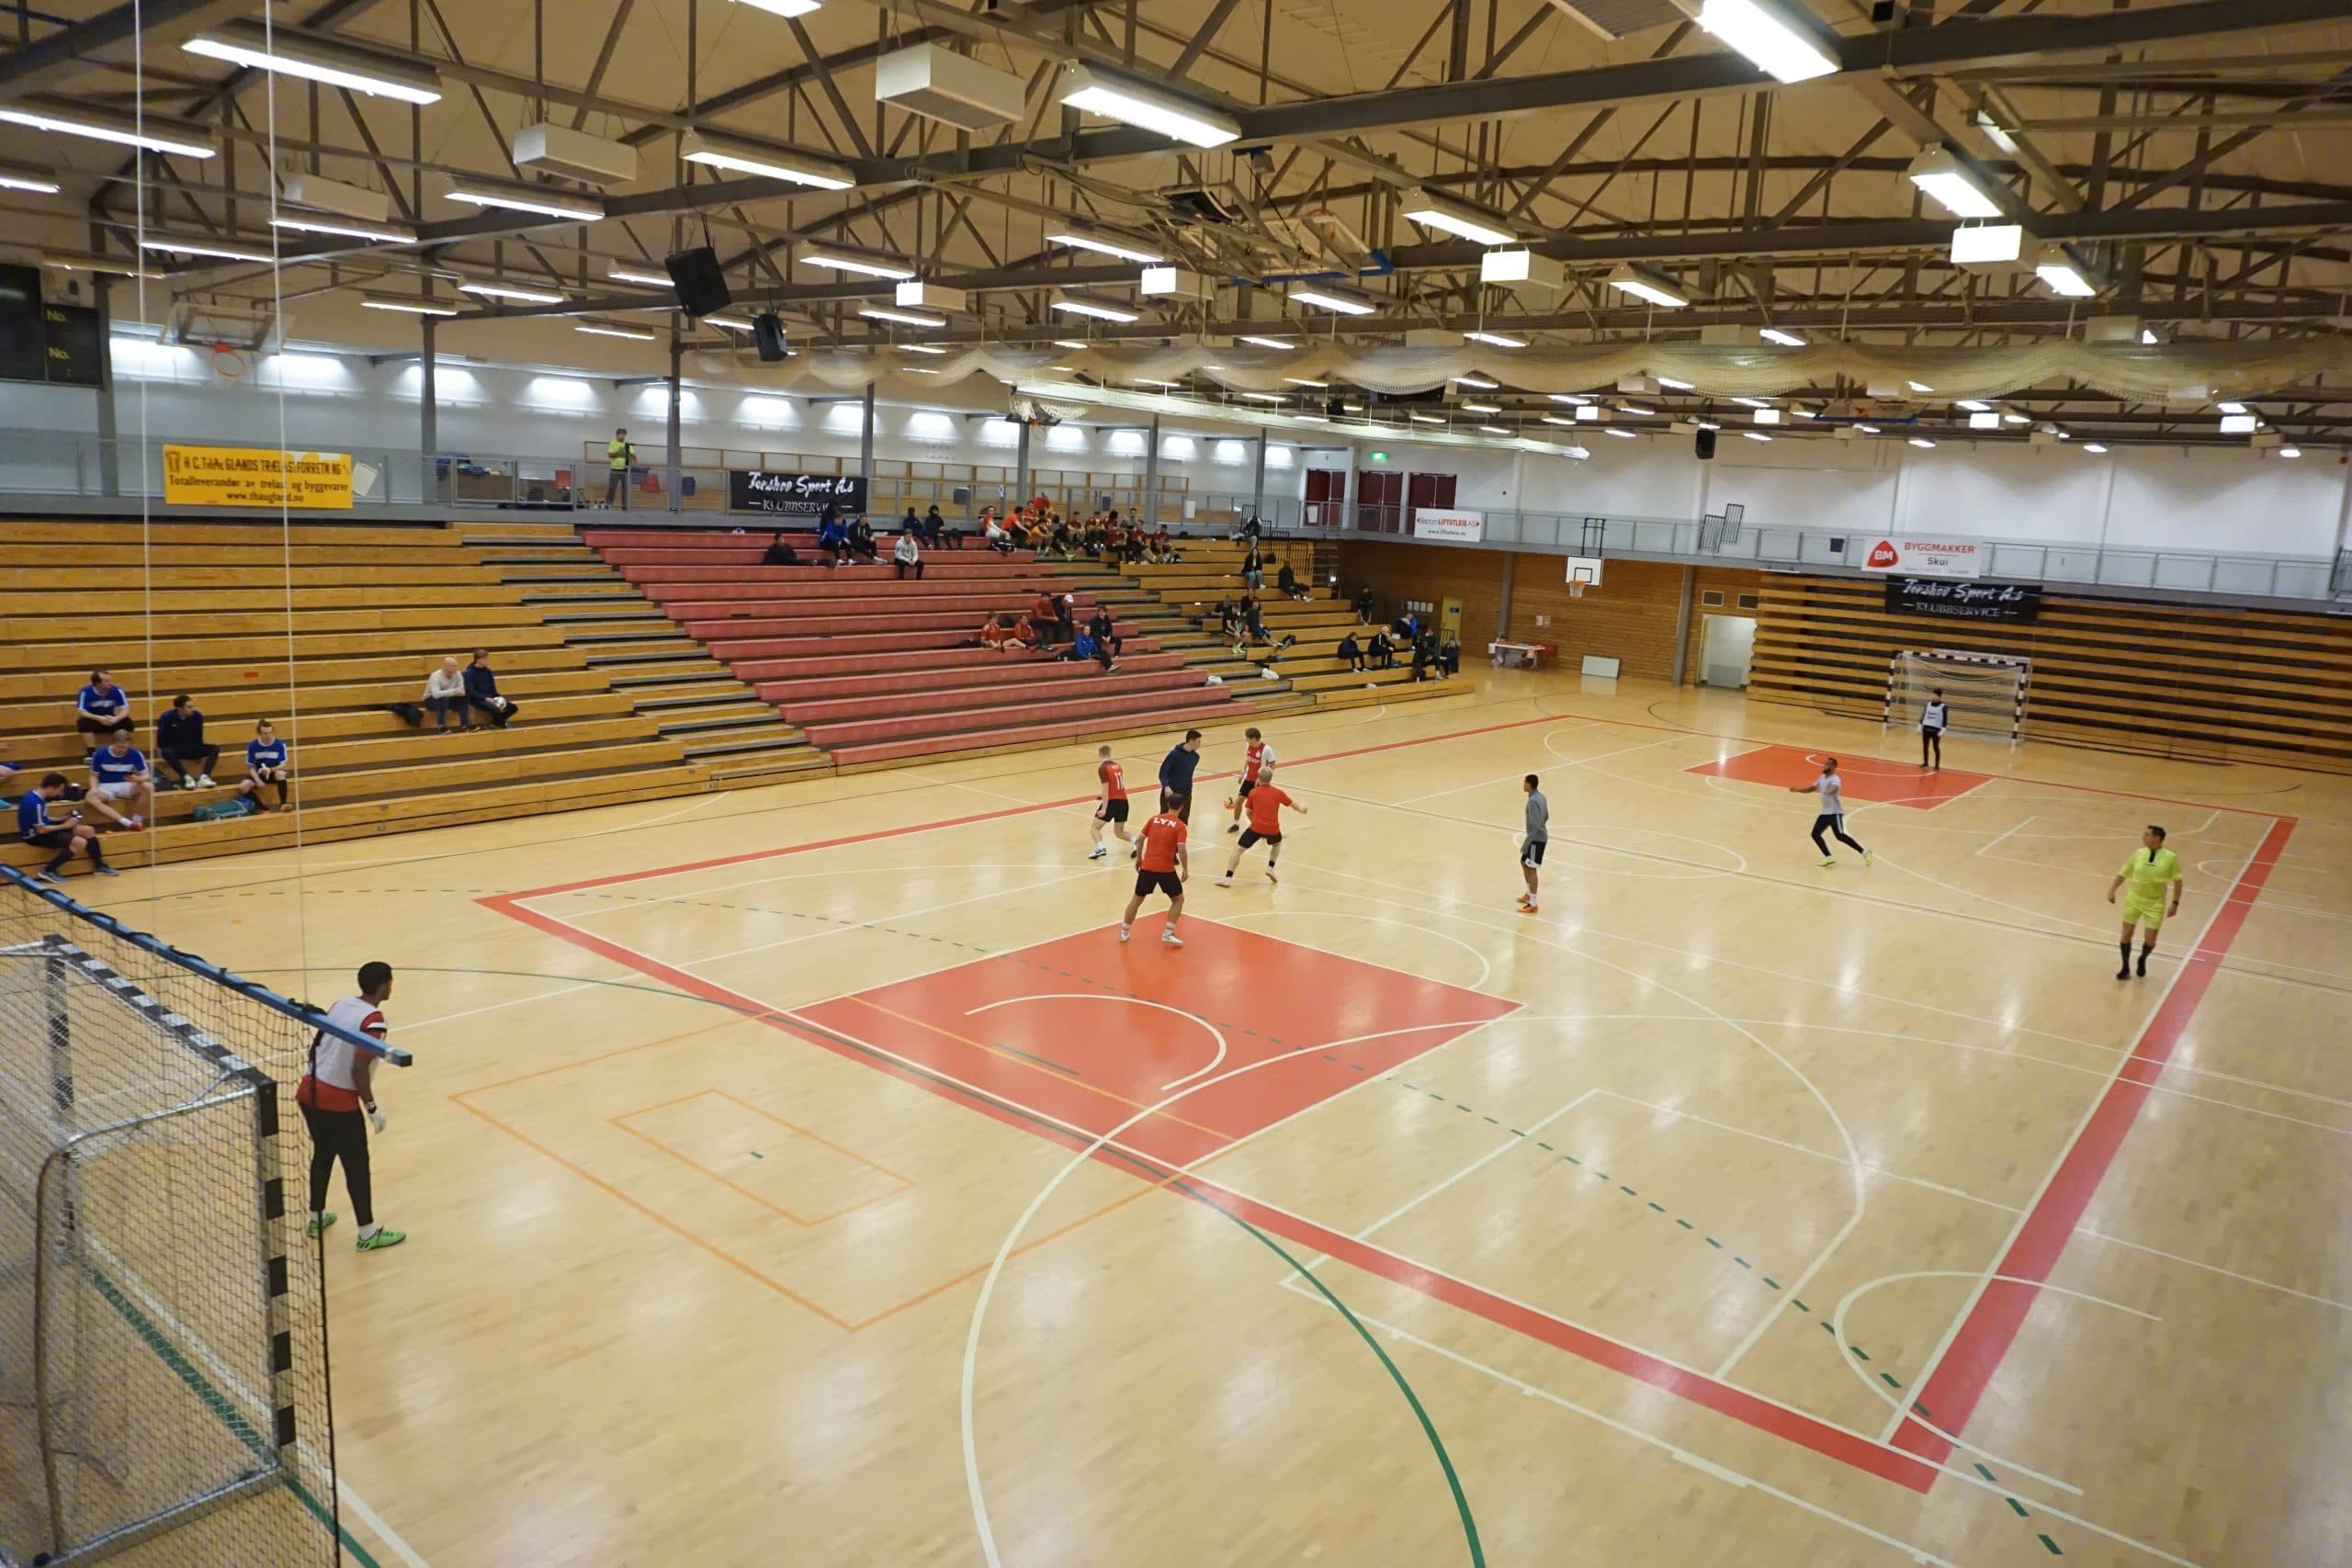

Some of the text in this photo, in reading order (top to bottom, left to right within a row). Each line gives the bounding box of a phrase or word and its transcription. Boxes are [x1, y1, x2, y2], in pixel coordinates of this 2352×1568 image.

[260, 479, 287, 490] trelas
[796, 475, 832, 498] Sport
[227, 491, 303, 503] www.thauglad.no
[1904, 542, 1975, 555] BYGGMAKKER
[1873, 550, 1894, 560] BM
[1928, 557, 1949, 566] Skui
[1953, 583, 1995, 603] Sport
[1916, 602, 2001, 617] KLUBBSERVICE
[1153, 817, 1177, 829] LYN
